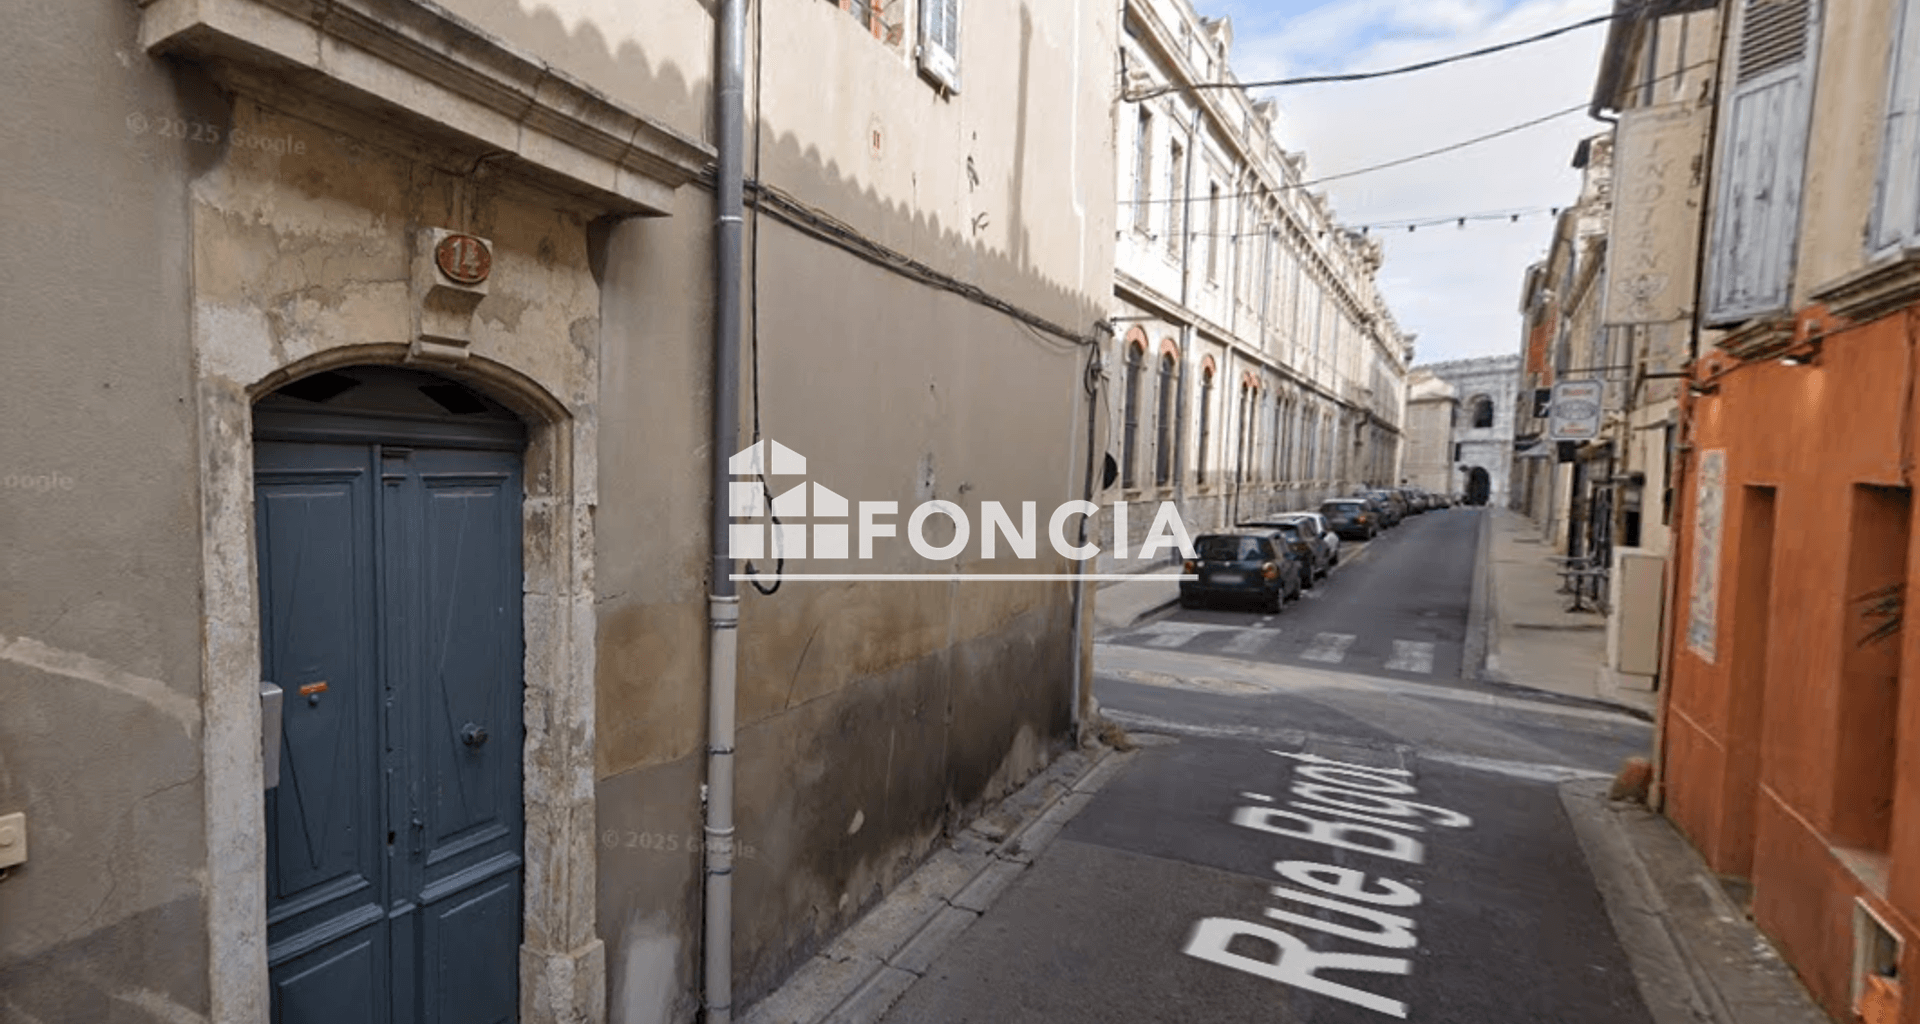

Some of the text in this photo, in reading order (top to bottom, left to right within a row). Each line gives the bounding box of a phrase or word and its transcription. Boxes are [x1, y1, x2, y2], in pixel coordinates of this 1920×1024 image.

[452, 238, 480, 276] 14
[1183, 749, 1473, 1018] Rue Bigot
